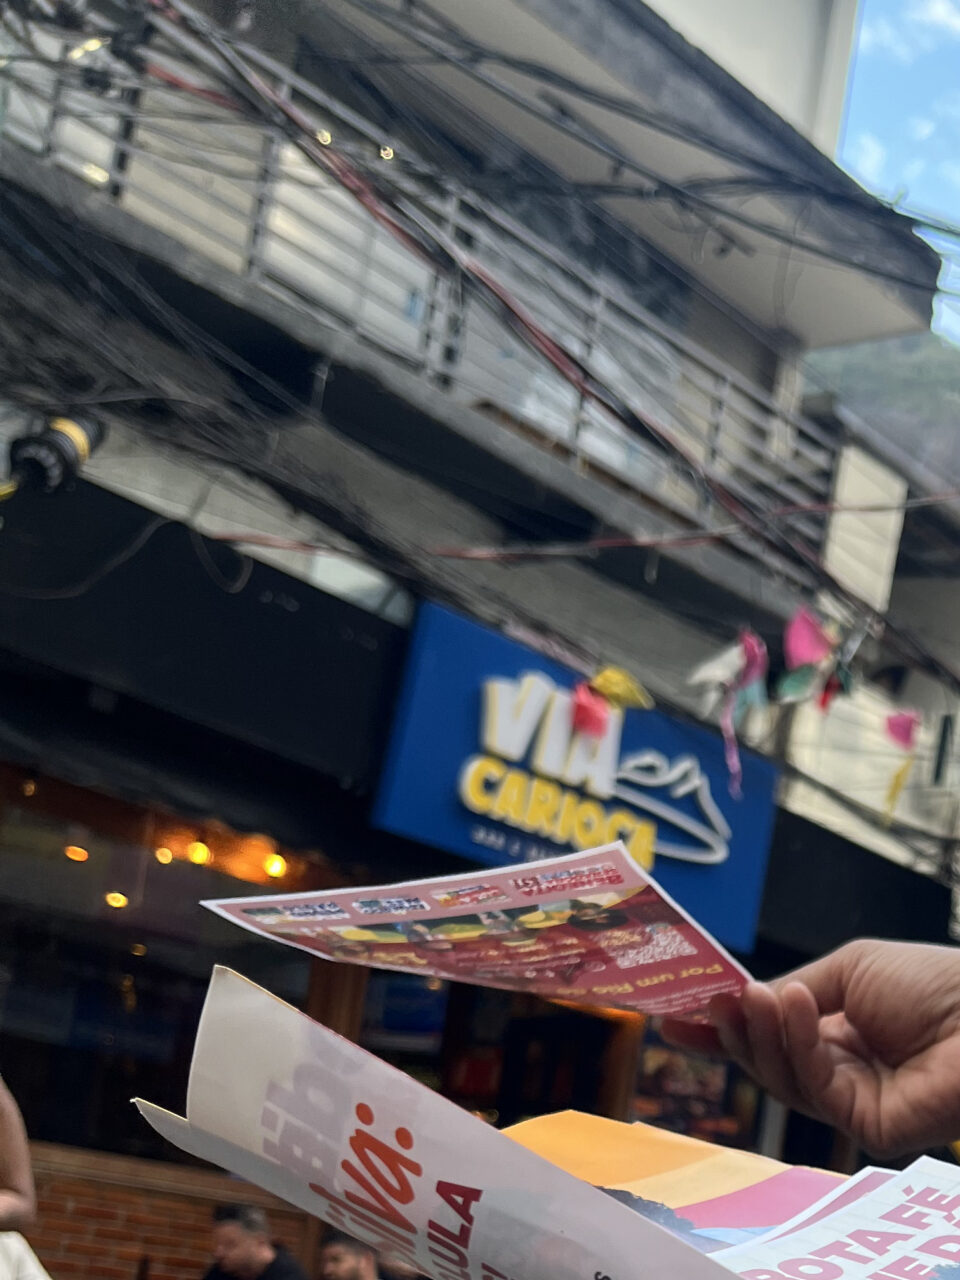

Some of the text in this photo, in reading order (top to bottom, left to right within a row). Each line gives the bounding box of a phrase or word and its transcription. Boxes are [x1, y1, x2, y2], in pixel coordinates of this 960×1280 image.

[482, 670, 625, 799] VIA
[460, 755, 658, 872] CARIOCA
[680, 964, 724, 979] Por
